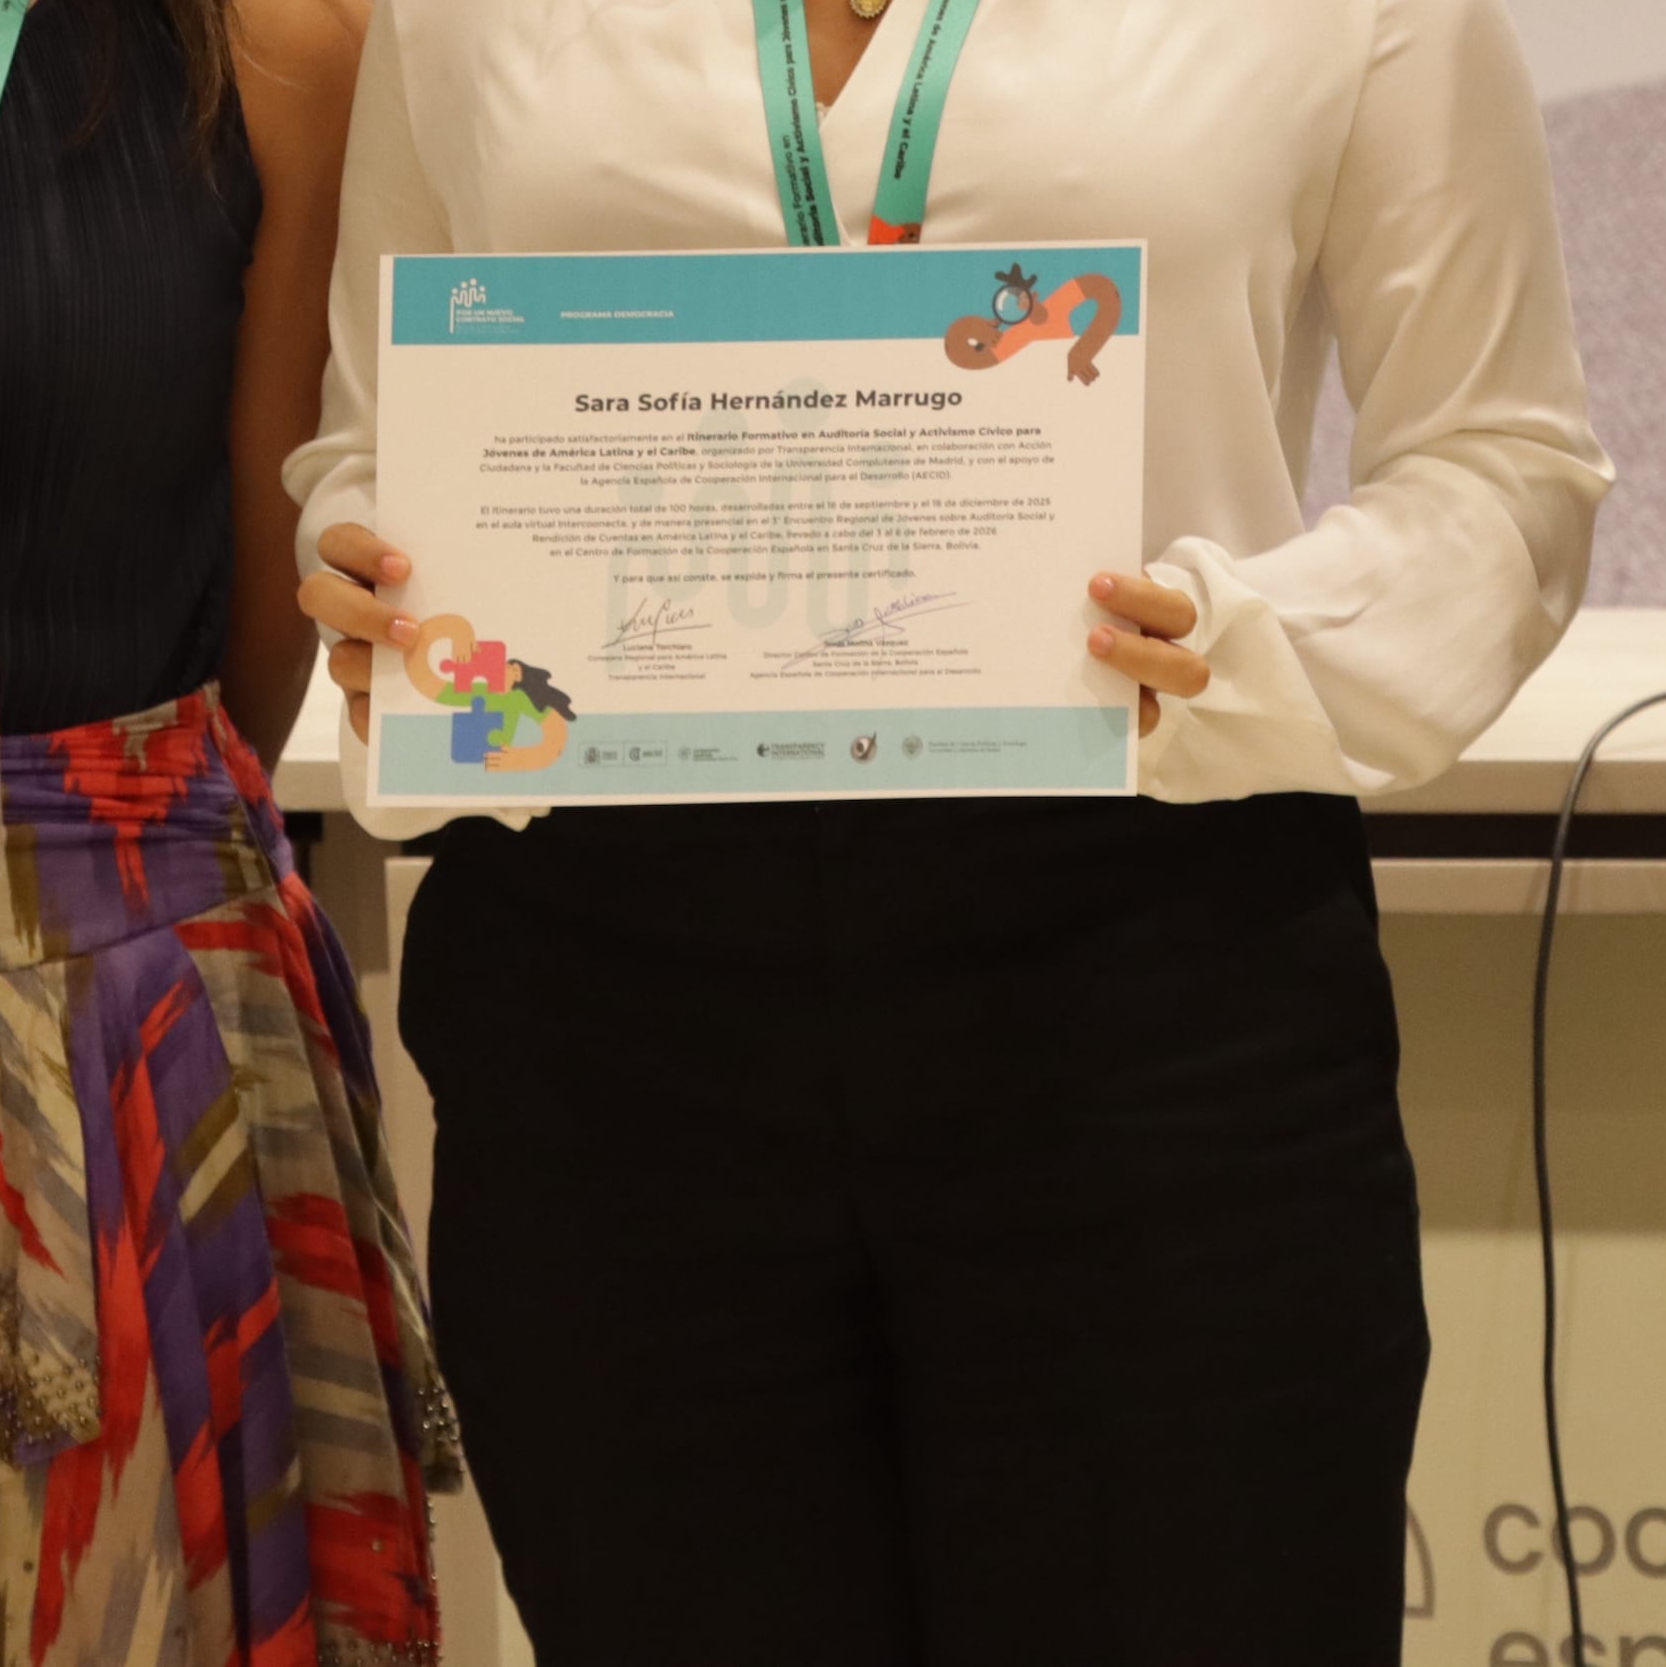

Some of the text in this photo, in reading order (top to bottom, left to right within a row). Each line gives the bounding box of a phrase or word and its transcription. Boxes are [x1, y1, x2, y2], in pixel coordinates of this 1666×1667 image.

[930, 23, 943, 37] de
[905, 81, 924, 116] Latina
[789, 98, 805, 152] Activismo
[902, 117, 912, 125] y
[901, 127, 912, 140] el
[892, 140, 909, 180] Caribe
[781, 135, 802, 208] Formativo en
[798, 166, 815, 201] Social
[561, 310, 674, 319] PROGRAMA DEMOCRACIA
[573, 389, 963, 411] Sara Sofía Hernández Marrugo
[493, 435, 506, 443] ha
[508, 434, 565, 445] participado
[567, 432, 658, 442] satisfactoriamente
[675, 432, 685, 441] el
[686, 431, 738, 441] Itinerario
[741, 430, 798, 440] Formativo
[817, 429, 870, 438] Auditoría
[872, 428, 907, 437] Social
[909, 430, 916, 438] y
[918, 427, 976, 437] Activismo
[977, 426, 1013, 436] Cívico
[1015, 428, 1041, 437] para
[482, 448, 529, 457] Jóvenes
[531, 448, 546, 457] de
[548, 447, 596, 457] América
[598, 446, 634, 456] Latina
[636, 448, 644, 457] y
[646, 446, 657, 455] el
[700, 445, 755, 456] organizado
[757, 446, 774, 455] por
[777, 444, 845, 455] Transparencia
[931, 441, 995, 451] colaboración
[996, 442, 1015, 450] con
[1017, 440, 1052, 449] Acción
[564, 547, 573, 556] el
[575, 547, 609, 556] Centro
[611, 547, 623, 556] de
[626, 545, 678, 555] Formación
[680, 546, 693, 555] de
[695, 545, 704, 554] la
[706, 544, 768, 555] Cooperación
[770, 543, 815, 554] Española
[831, 543, 859, 552] Santa
[861, 542, 883, 551] Cruz
[886, 542, 899, 551] de
[901, 542, 910, 550] la
[613, 573, 619, 582] Y
[621, 575, 643, 583] para
[645, 574, 664, 583] que
[667, 573, 680, 582] así
[720, 573, 731, 581] se
[733, 571, 767, 582] expide
[769, 573, 774, 582] y
[777, 570, 803, 580] firma
[805, 571, 814, 579] el
[816, 570, 859, 580] presente
